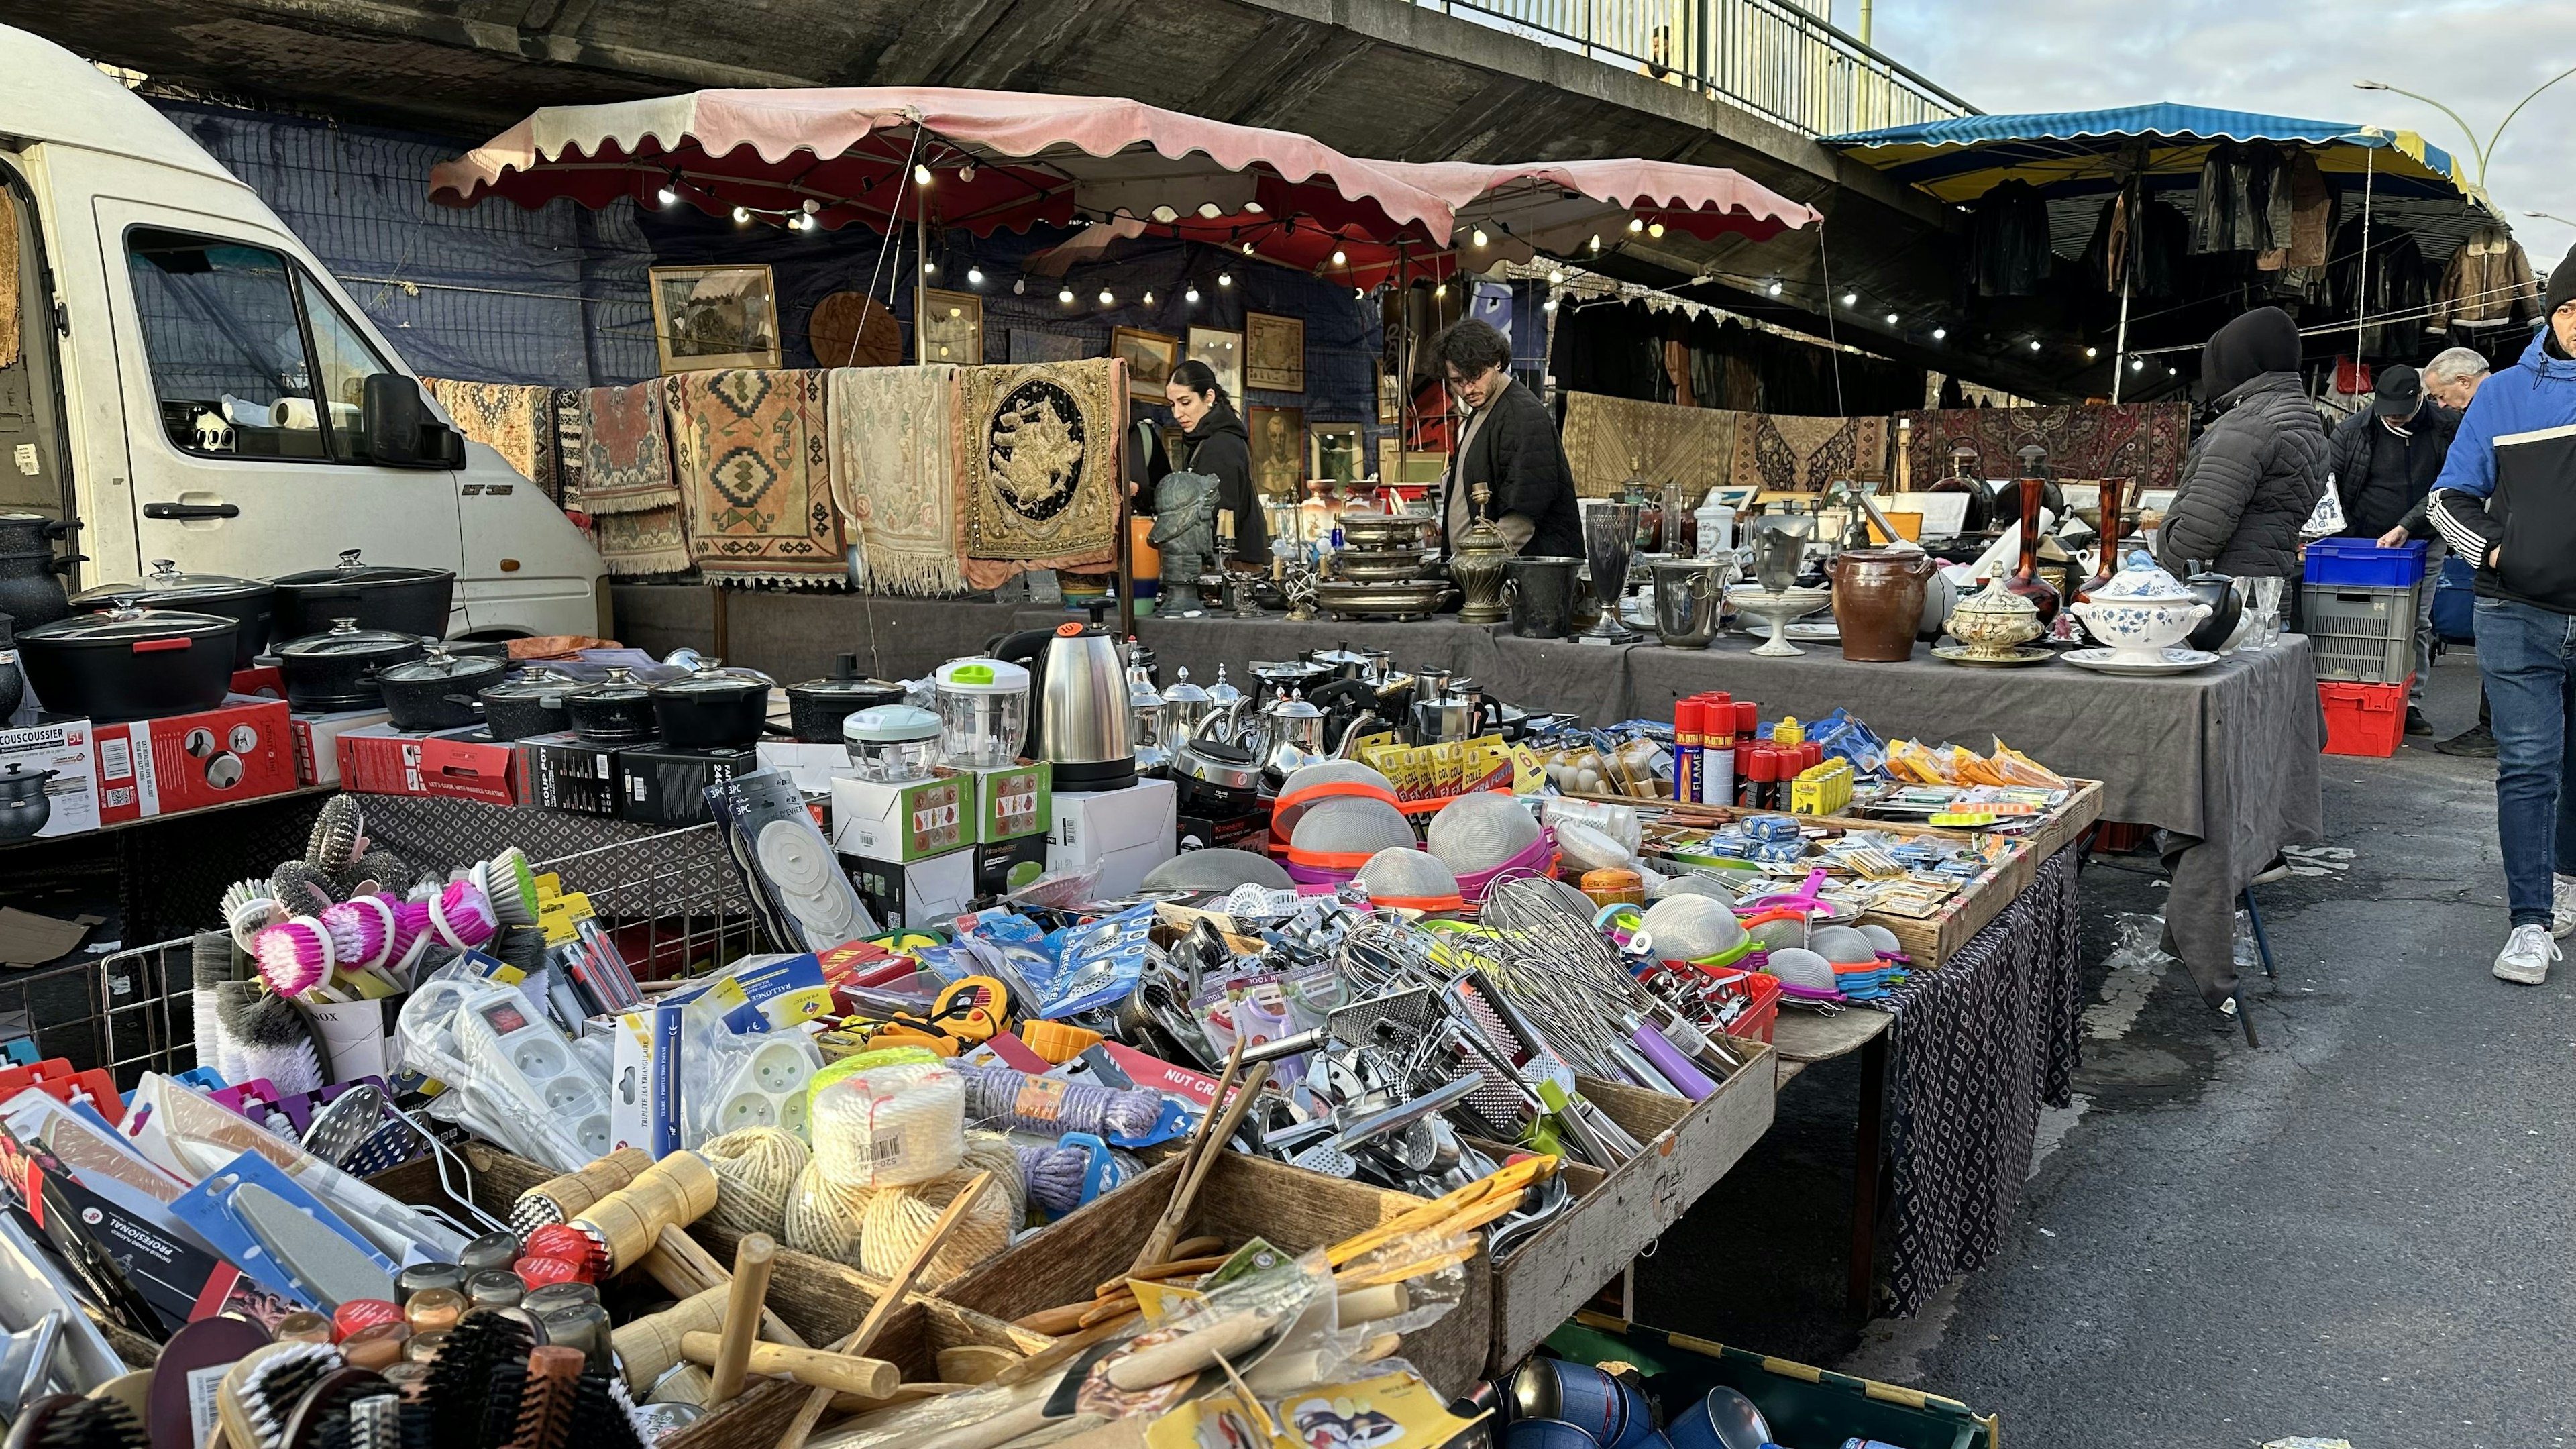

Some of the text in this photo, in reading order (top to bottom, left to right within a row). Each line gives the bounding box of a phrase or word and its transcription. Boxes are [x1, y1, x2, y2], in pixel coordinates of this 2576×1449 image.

[462, 484, 513, 495] LT 35
[0, 729, 82, 745] COUSCOUSSIER 5L
[1519, 752, 1532, 768] 6
[1465, 769, 1482, 784] COLLE
[1693, 753, 1702, 790] FLAME
[542, 773, 550, 807] SOUP
[710, 788, 724, 799] 3PC
[728, 784, 742, 795] 3PC
[736, 804, 751, 816] 3PC
[780, 806, 803, 818] D'EVIER
[1049, 939, 1075, 1002] STAINLESS STEEL
[1248, 975, 1268, 984] TOOL
[750, 983, 791, 1002] RALLONGE
[794, 992, 819, 1004] PRATEC
[1205, 994, 1221, 1002] TOOL
[641, 1040, 649, 1084] TRIANGULAIRE
[1164, 1069, 1195, 1087] NUT
[110, 1218, 173, 1256] PROFESIONAL
[111, 1229, 172, 1264] CUCHILLO MANGO PLÁSTICO
